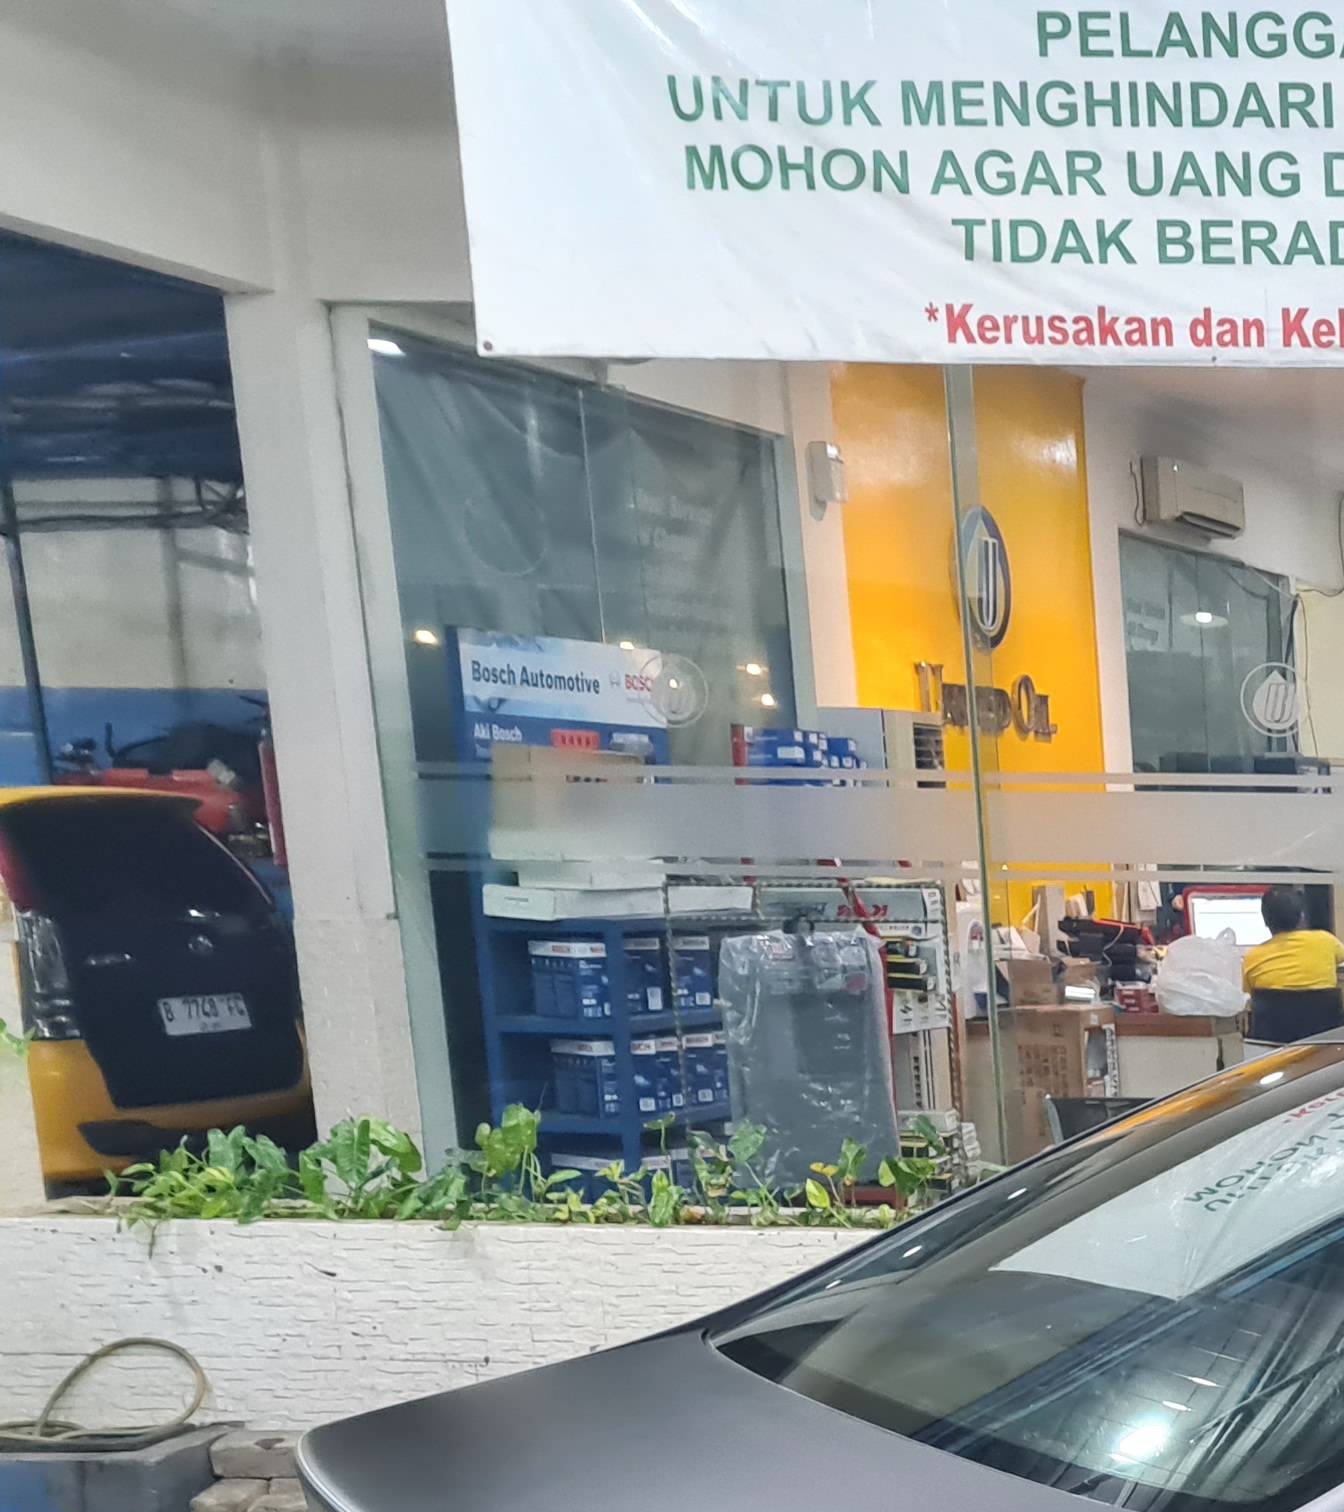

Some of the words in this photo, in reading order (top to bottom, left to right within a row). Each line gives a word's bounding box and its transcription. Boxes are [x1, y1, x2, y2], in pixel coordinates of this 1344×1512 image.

[664, 73, 881, 129] UNTUK
[899, 79, 1335, 130] MENGHINDARI
[683, 143, 910, 196] MOHON
[930, 148, 1105, 198] AGAR
[1126, 148, 1302, 200] UANG
[951, 217, 1134, 267] TIDAK
[1189, 308, 1266, 349] dan
[470, 660, 517, 686] Bosch
[519, 665, 601, 695] Automotive
[491, 724, 523, 742] Bosch
